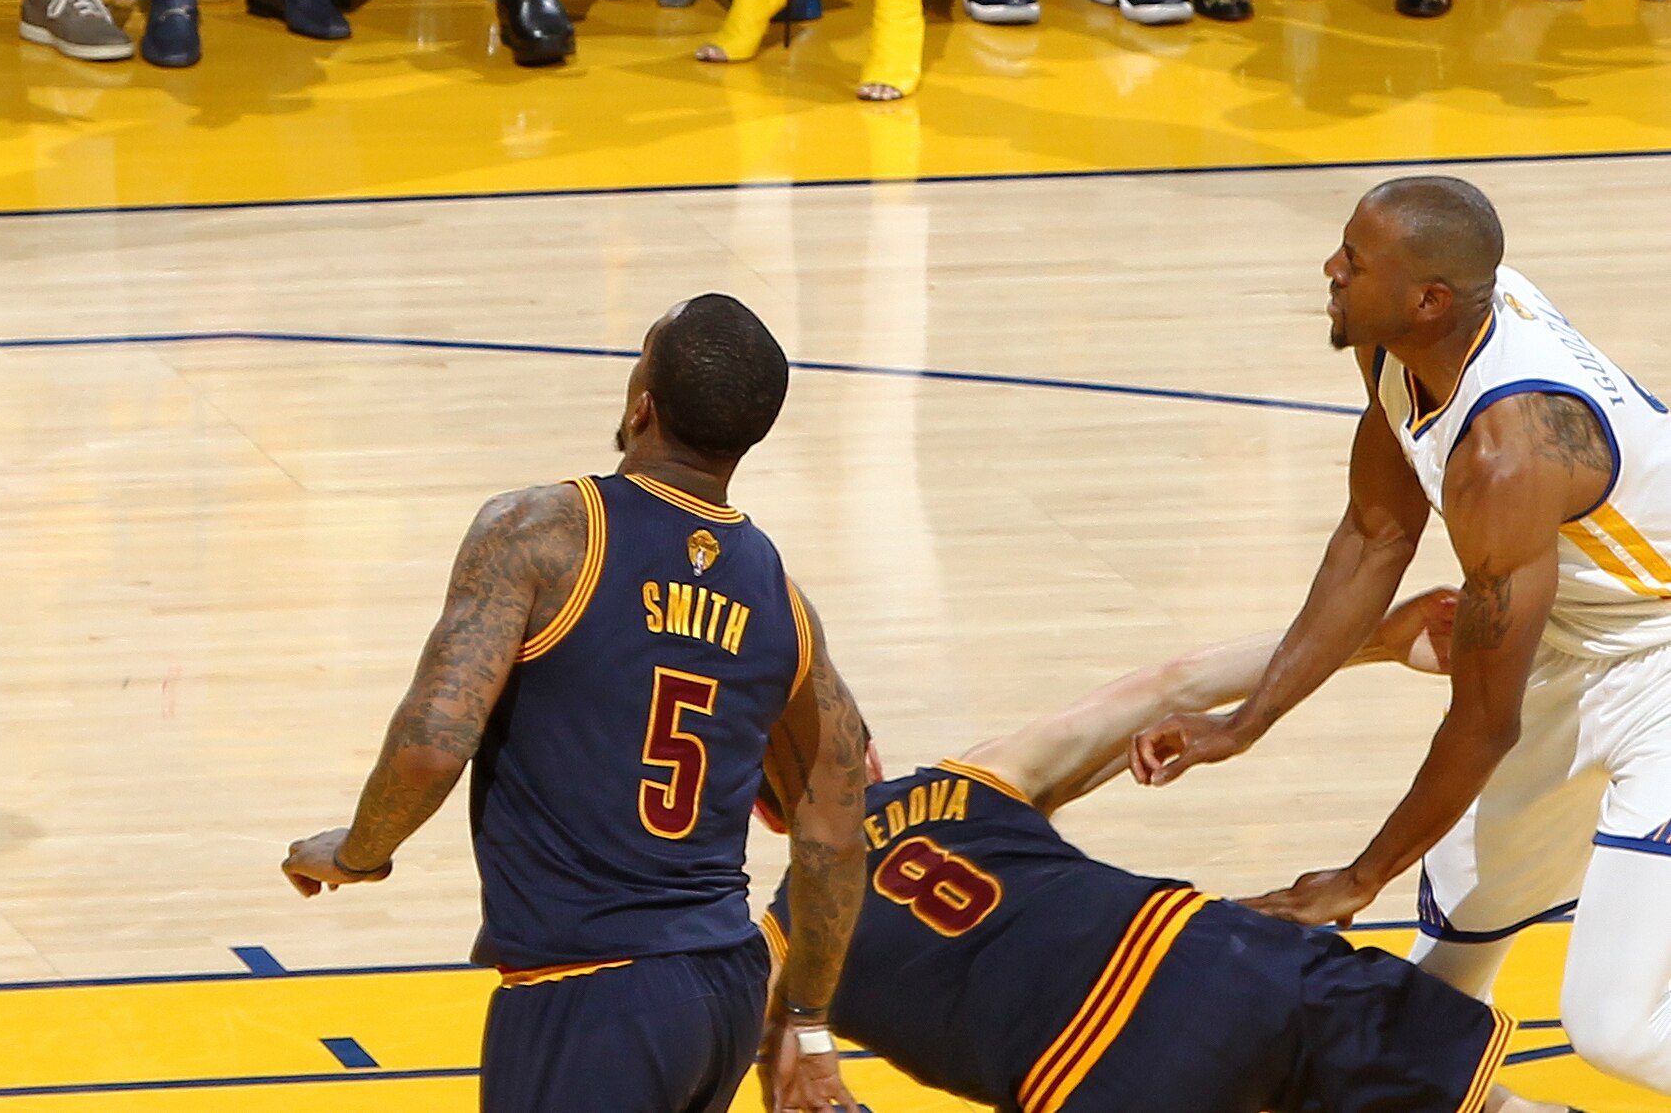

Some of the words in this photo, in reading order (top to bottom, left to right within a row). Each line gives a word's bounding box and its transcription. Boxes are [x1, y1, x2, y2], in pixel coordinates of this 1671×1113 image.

[641, 579, 751, 656] SMITH
[638, 664, 719, 840] 5
[862, 777, 971, 852] EDOVA
[872, 835, 1004, 938] 8
